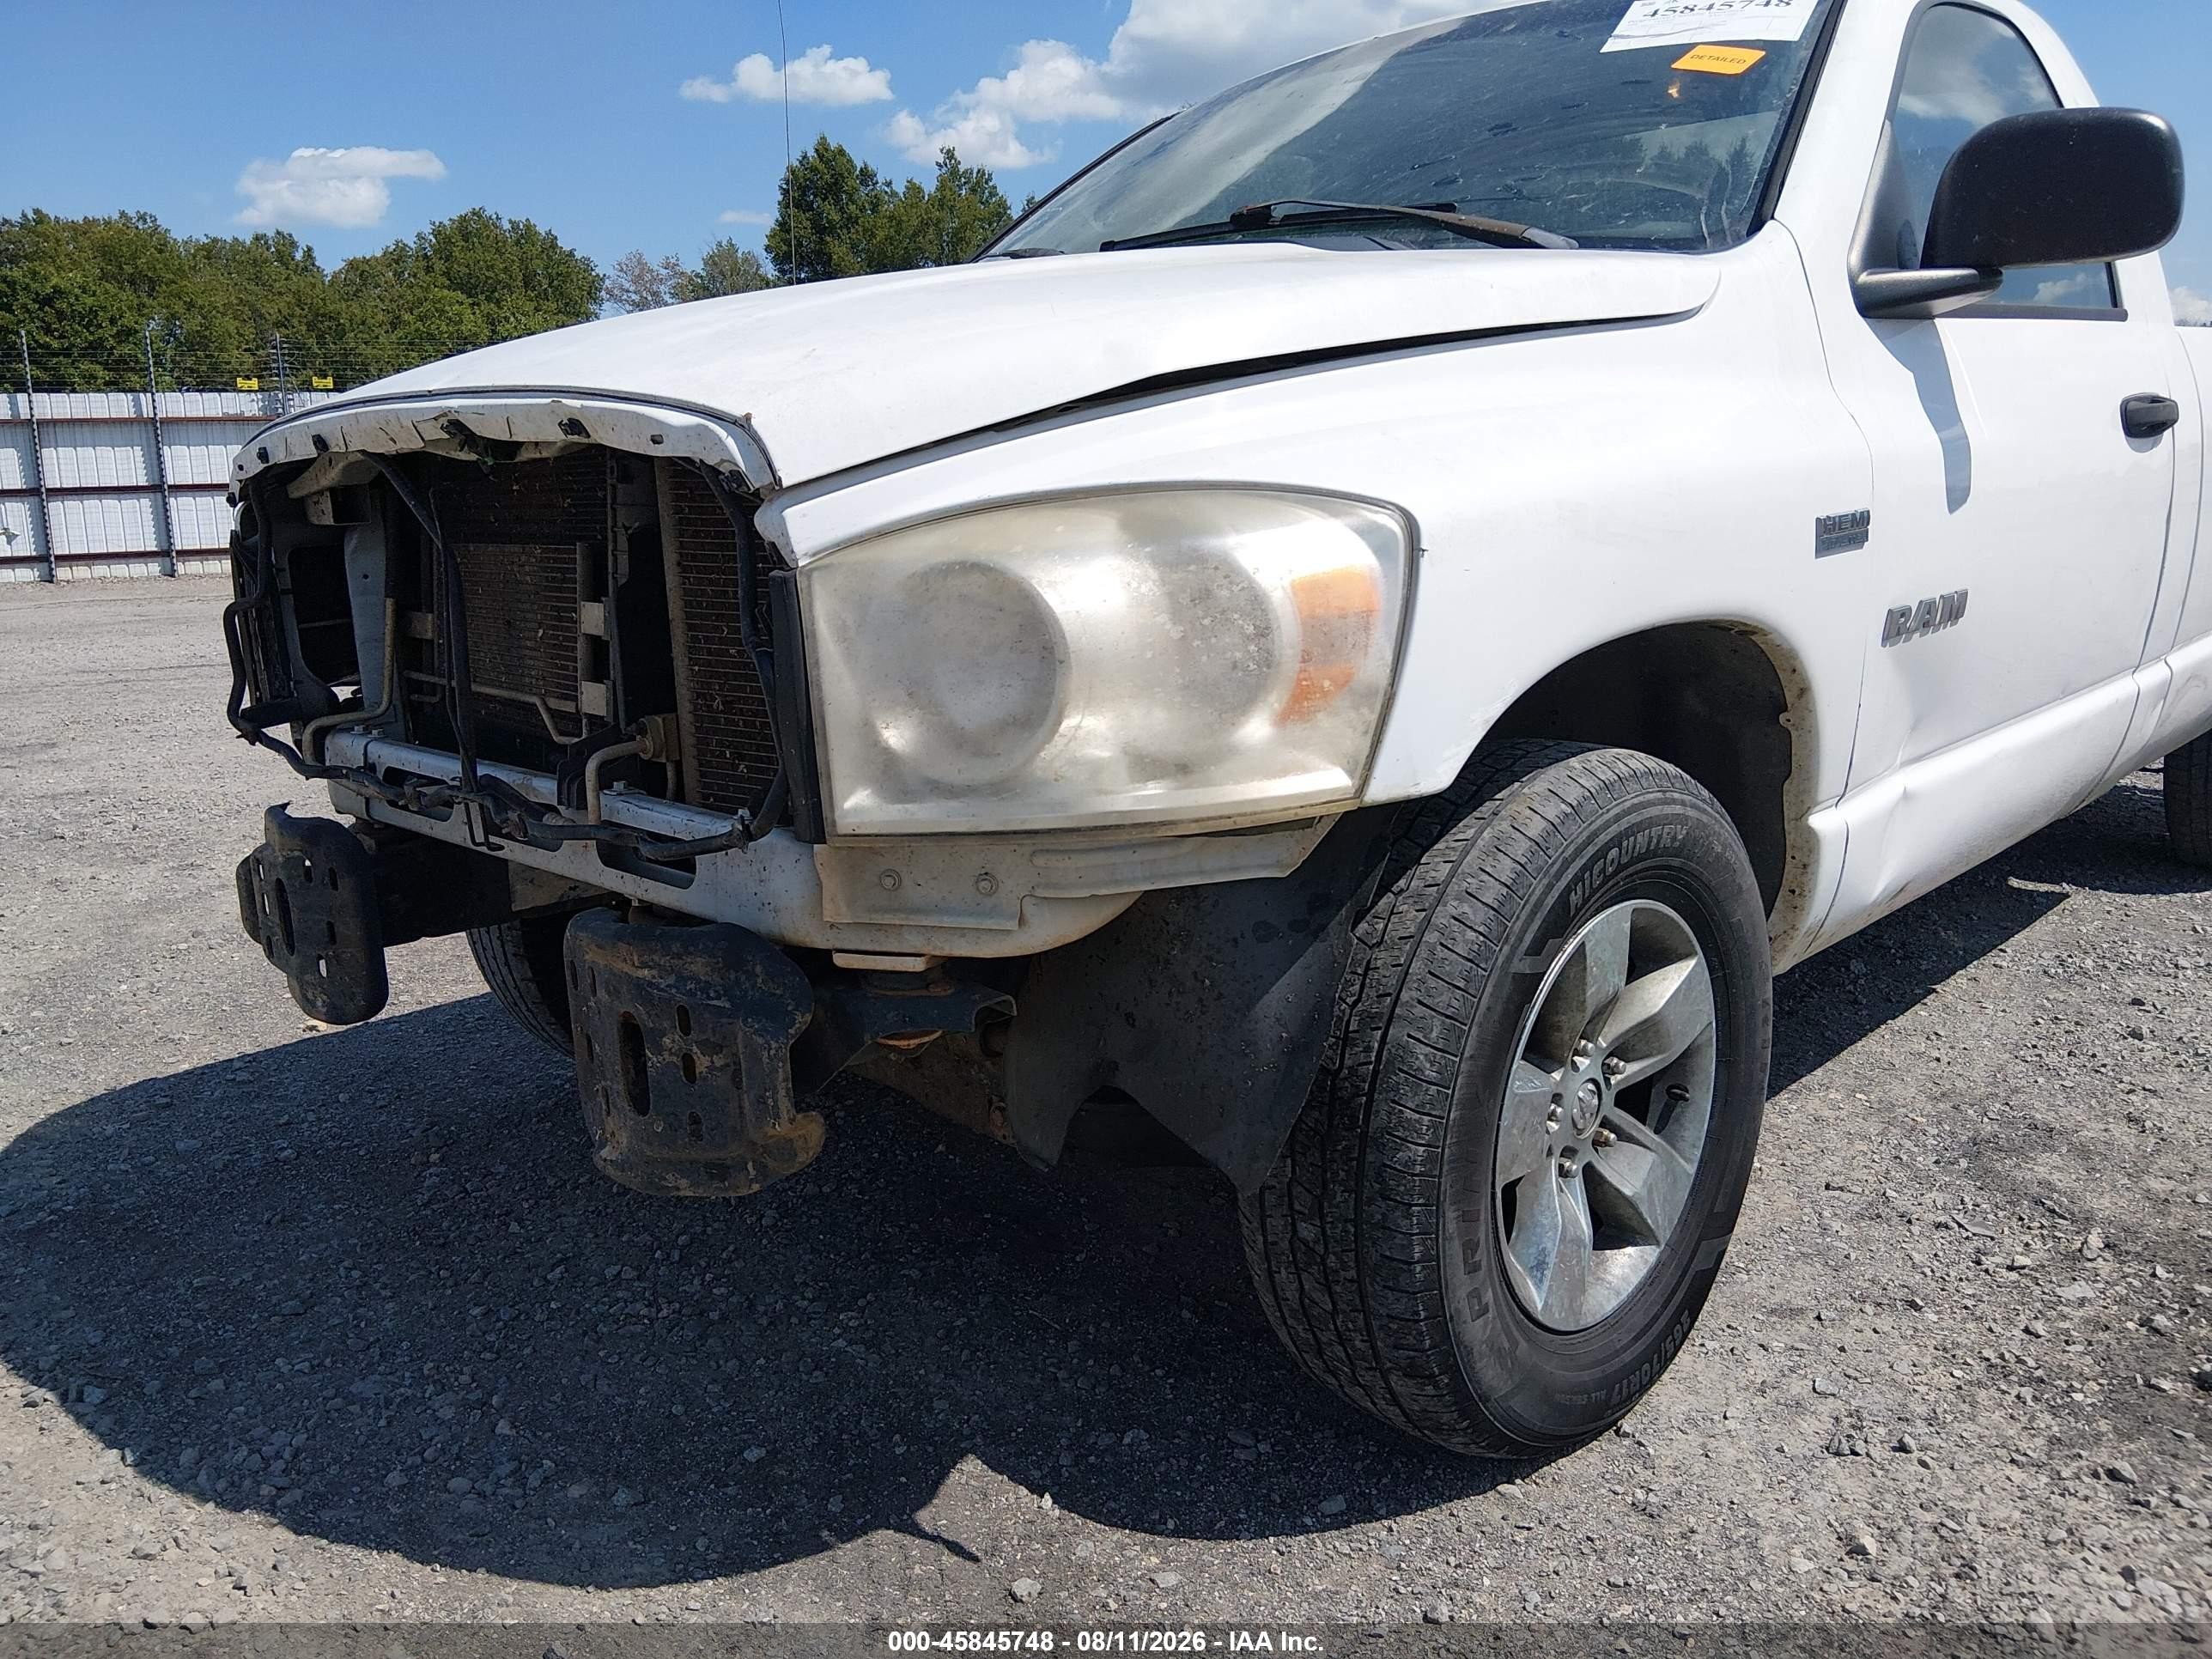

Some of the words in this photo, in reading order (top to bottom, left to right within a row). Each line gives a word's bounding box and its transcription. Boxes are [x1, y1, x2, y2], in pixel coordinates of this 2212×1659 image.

[1642, 0, 1792, 17] 45845748
[1690, 54, 1747, 64] DETAILED
[1819, 508, 1870, 536] HEMI
[1881, 589, 1968, 647] RAM
